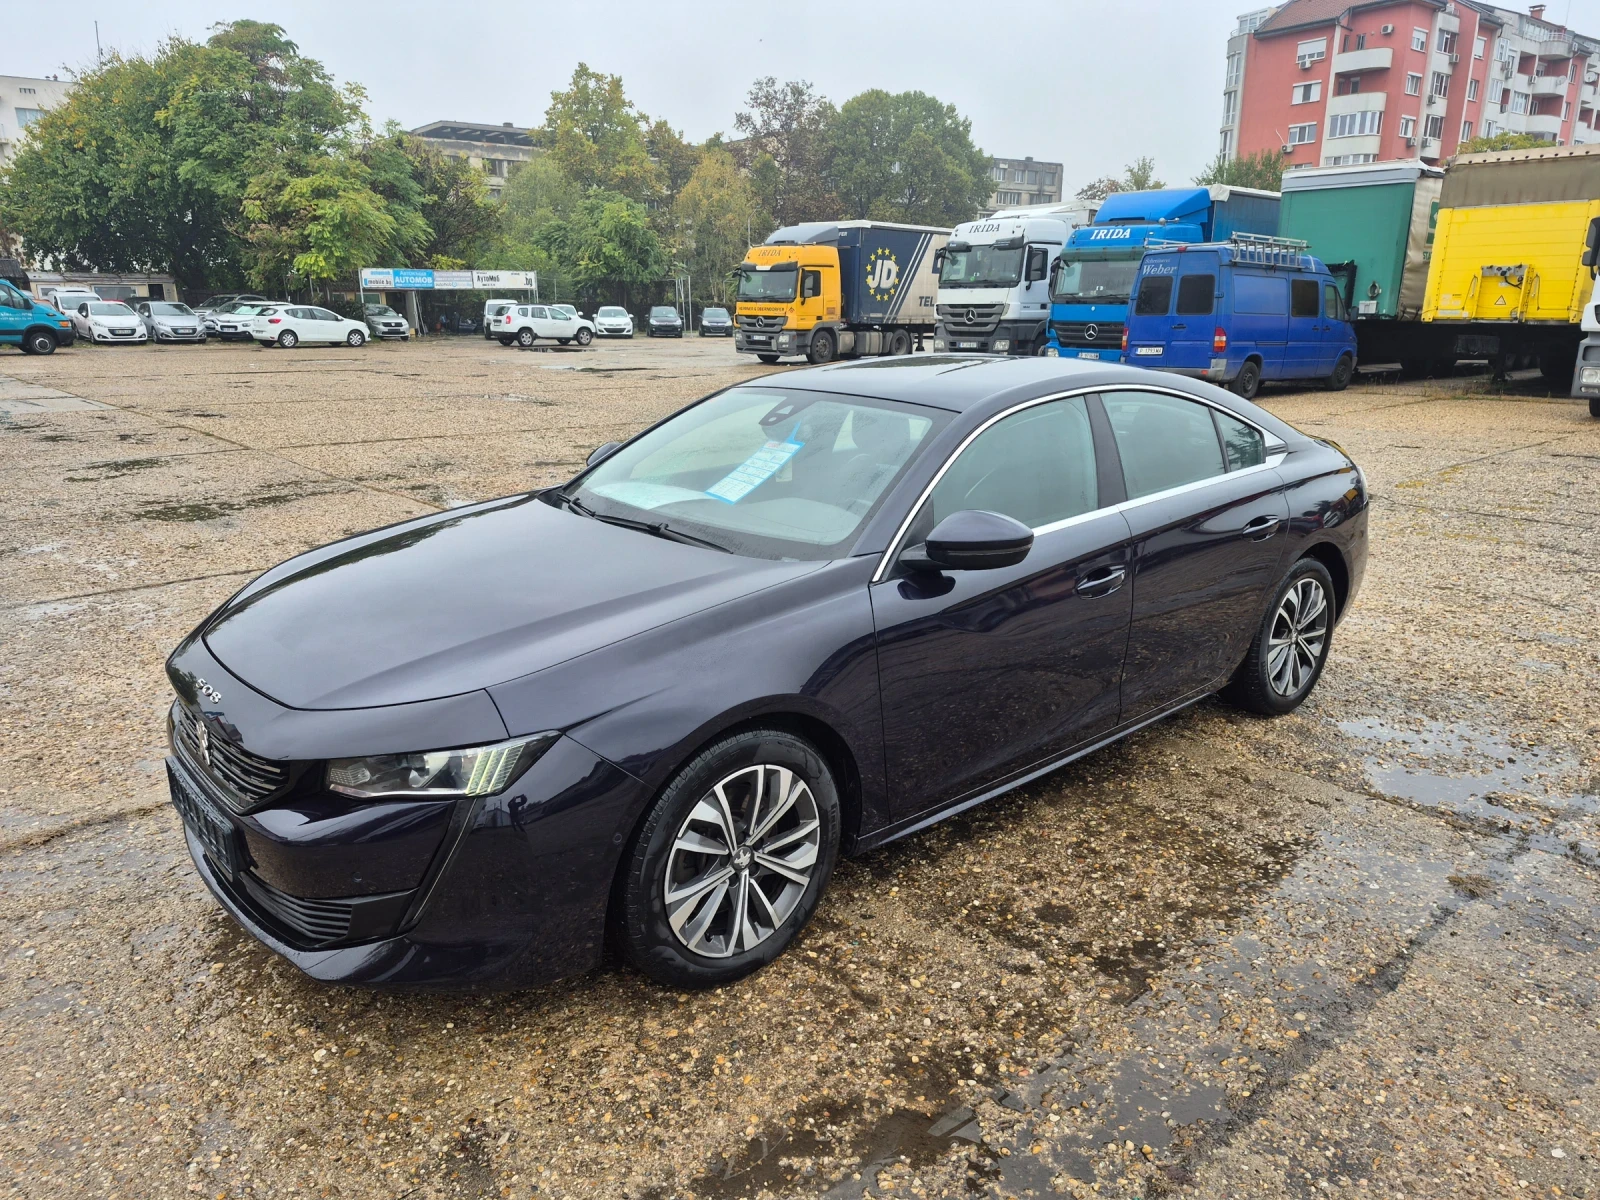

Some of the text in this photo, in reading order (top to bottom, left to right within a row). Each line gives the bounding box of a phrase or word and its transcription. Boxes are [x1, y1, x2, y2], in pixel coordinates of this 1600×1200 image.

[968, 223, 1000, 233] IRIDA
[1090, 228, 1131, 240] IRIDA
[758, 249, 781, 257] IRIDA
[867, 259, 897, 289] JD
[1142, 264, 1178, 275] Weber
